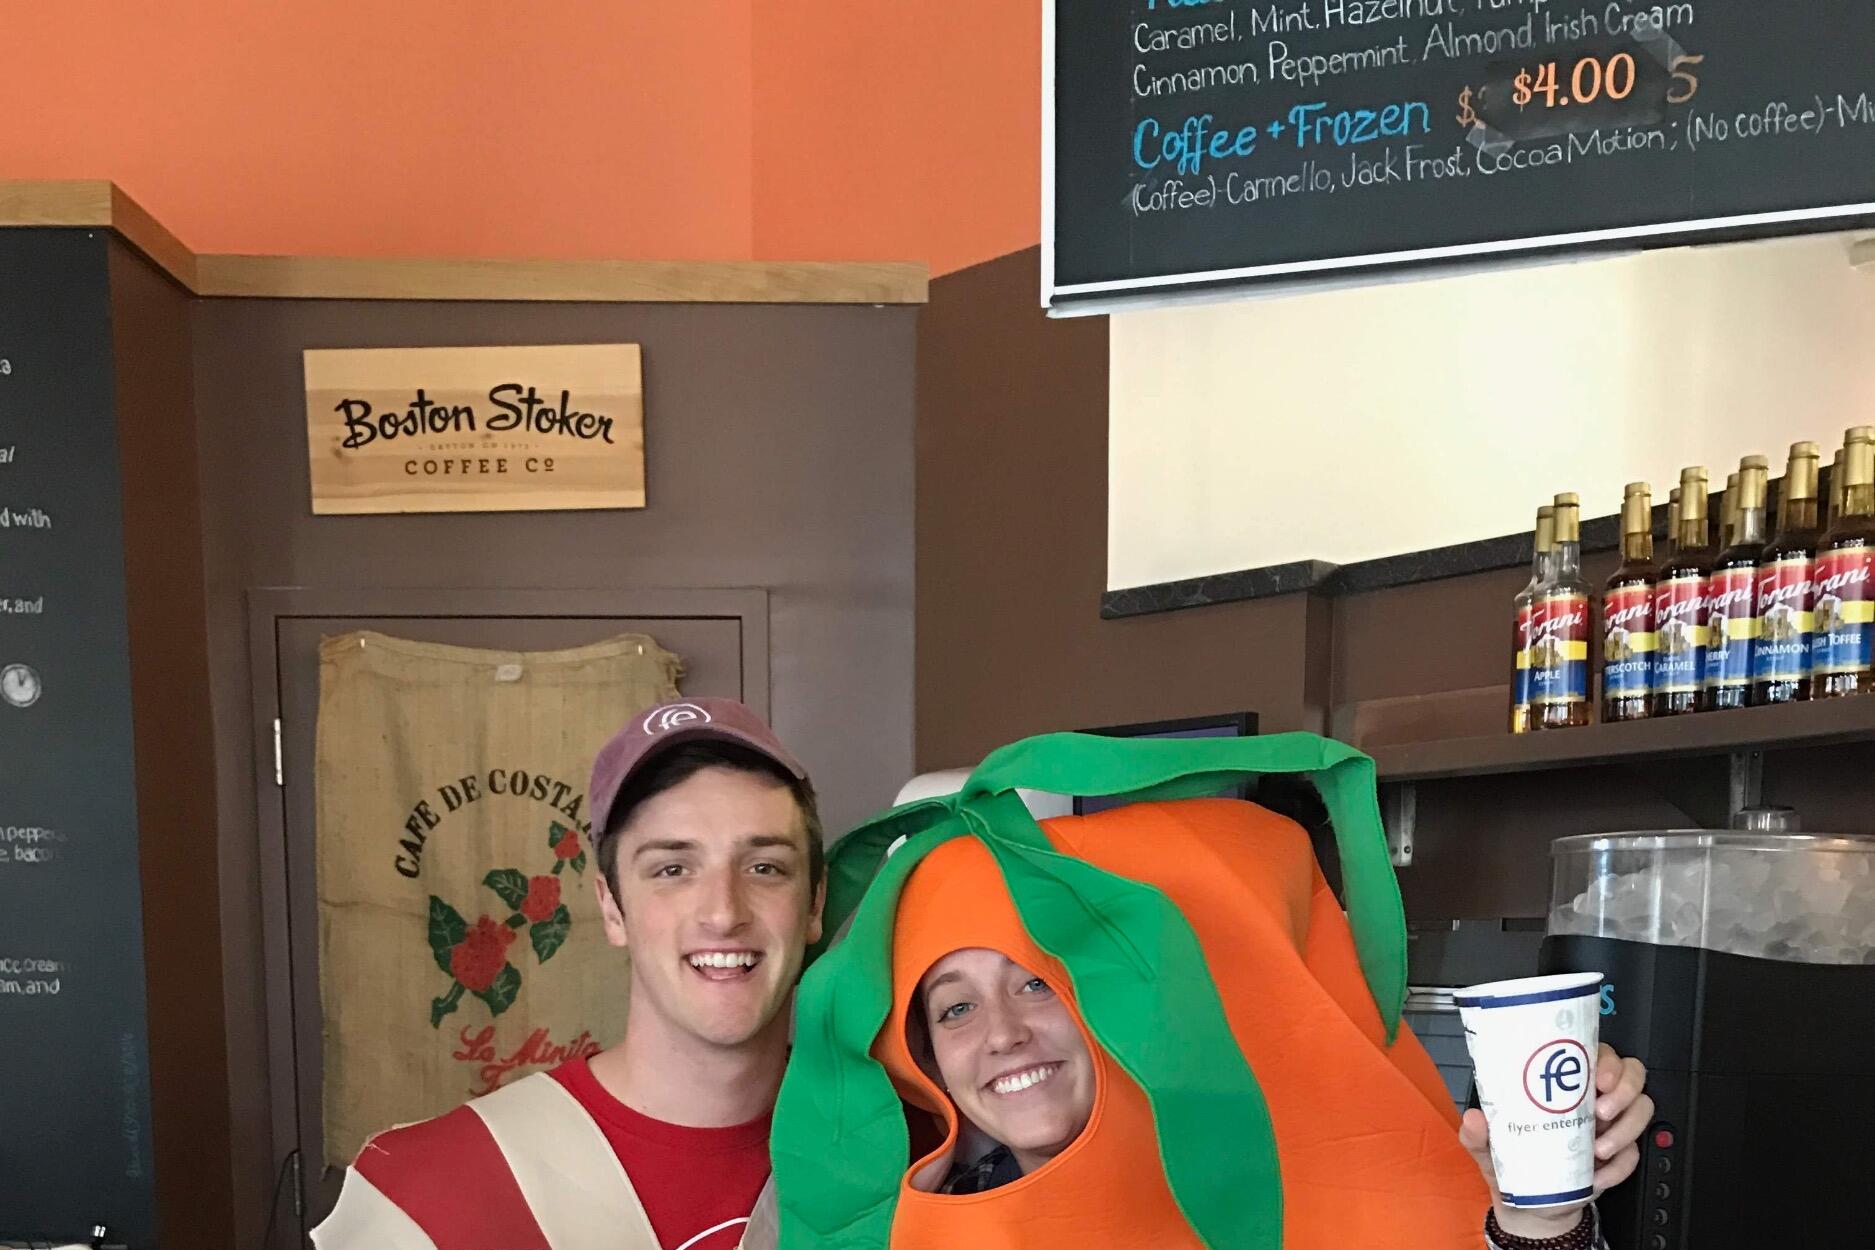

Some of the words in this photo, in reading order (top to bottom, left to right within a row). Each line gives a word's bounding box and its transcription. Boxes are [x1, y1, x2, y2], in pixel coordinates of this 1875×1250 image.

[1133, 64, 1261, 97] Cinnamon,
[1545, 8, 1598, 44] Irish
[1604, 2, 1694, 36] Cream
[1134, 10, 1243, 53] Caramel,
[1512, 53, 1636, 112] $4.00
[1133, 113, 1257, 175] Coffee
[1342, 147, 1401, 188] Jack
[1406, 144, 1471, 182] Frost,
[1476, 141, 1563, 175] Cocoa
[1686, 108, 1729, 152] (No
[334, 388, 477, 450] Boston
[486, 383, 616, 445] Stoker
[404, 458, 509, 476] COFFEE
[12, 507, 52, 529] with
[1828, 633, 1862, 646] TOFFEE
[1534, 669, 1561, 682] APPLE
[1654, 660, 1696, 674] CARAMEL
[394, 799, 442, 879] CAFE
[437, 775, 482, 812] DE
[488, 768, 584, 820] COSTA
[1540, 1048, 1581, 1102] fe
[1507, 1121, 1538, 1136] flyer
